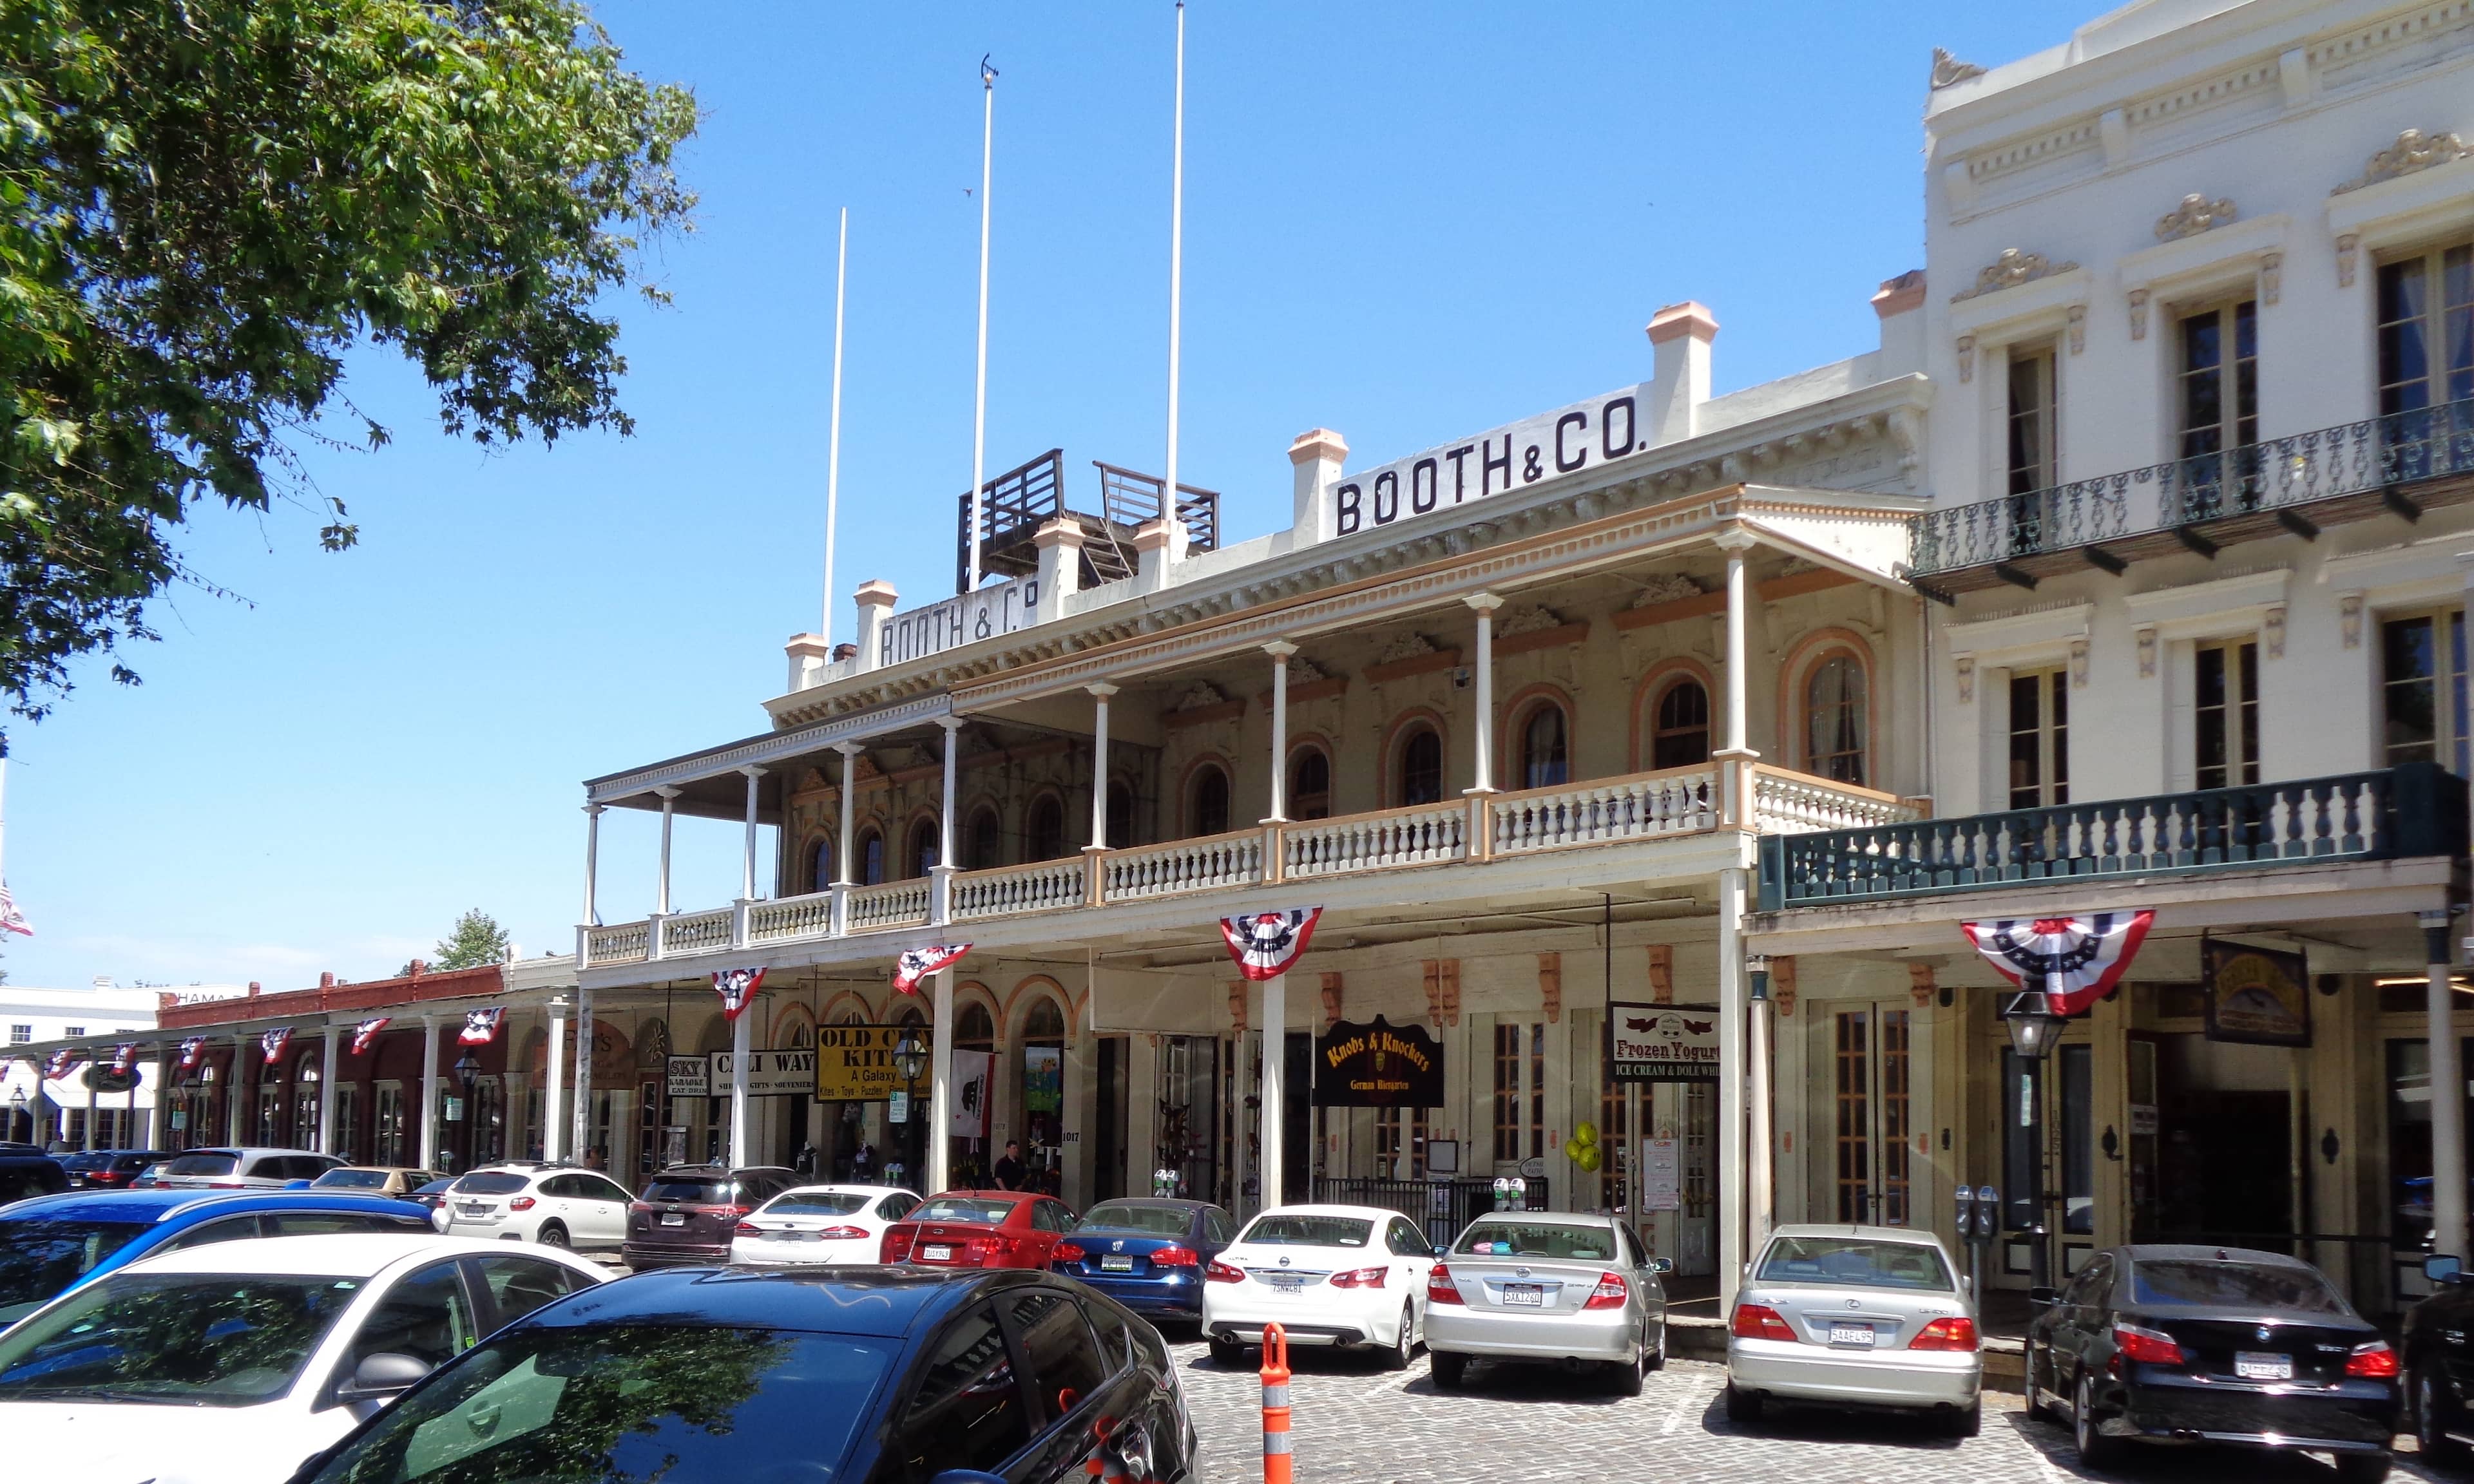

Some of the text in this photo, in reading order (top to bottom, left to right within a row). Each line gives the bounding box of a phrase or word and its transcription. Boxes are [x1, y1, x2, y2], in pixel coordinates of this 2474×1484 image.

[1337, 396, 1647, 537] BOOTH & CO.
[881, 604, 964, 667] BOOTH
[975, 607, 992, 640] &
[564, 1030, 611, 1052] FT'S
[821, 1029, 871, 1047] OLD
[1327, 1032, 1429, 1072] Knobs & Knockers
[1617, 1040, 1670, 1058] Frozen
[670, 1061, 702, 1076] SKY
[775, 1054, 814, 1071] WAY
[1616, 1065, 1720, 1076] ICE CREAM & DOLE WHI
[851, 1070, 896, 1083] A Galaxy
[820, 1086, 834, 1096] Kites
[841, 1086, 854, 1097] Toys
[861, 1086, 882, 1096] Puzzles
[1350, 1080, 1409, 1091] German Biergarten
[1063, 1132, 1079, 1141] 1017
[1832, 1329, 1872, 1342] 5AAE495
